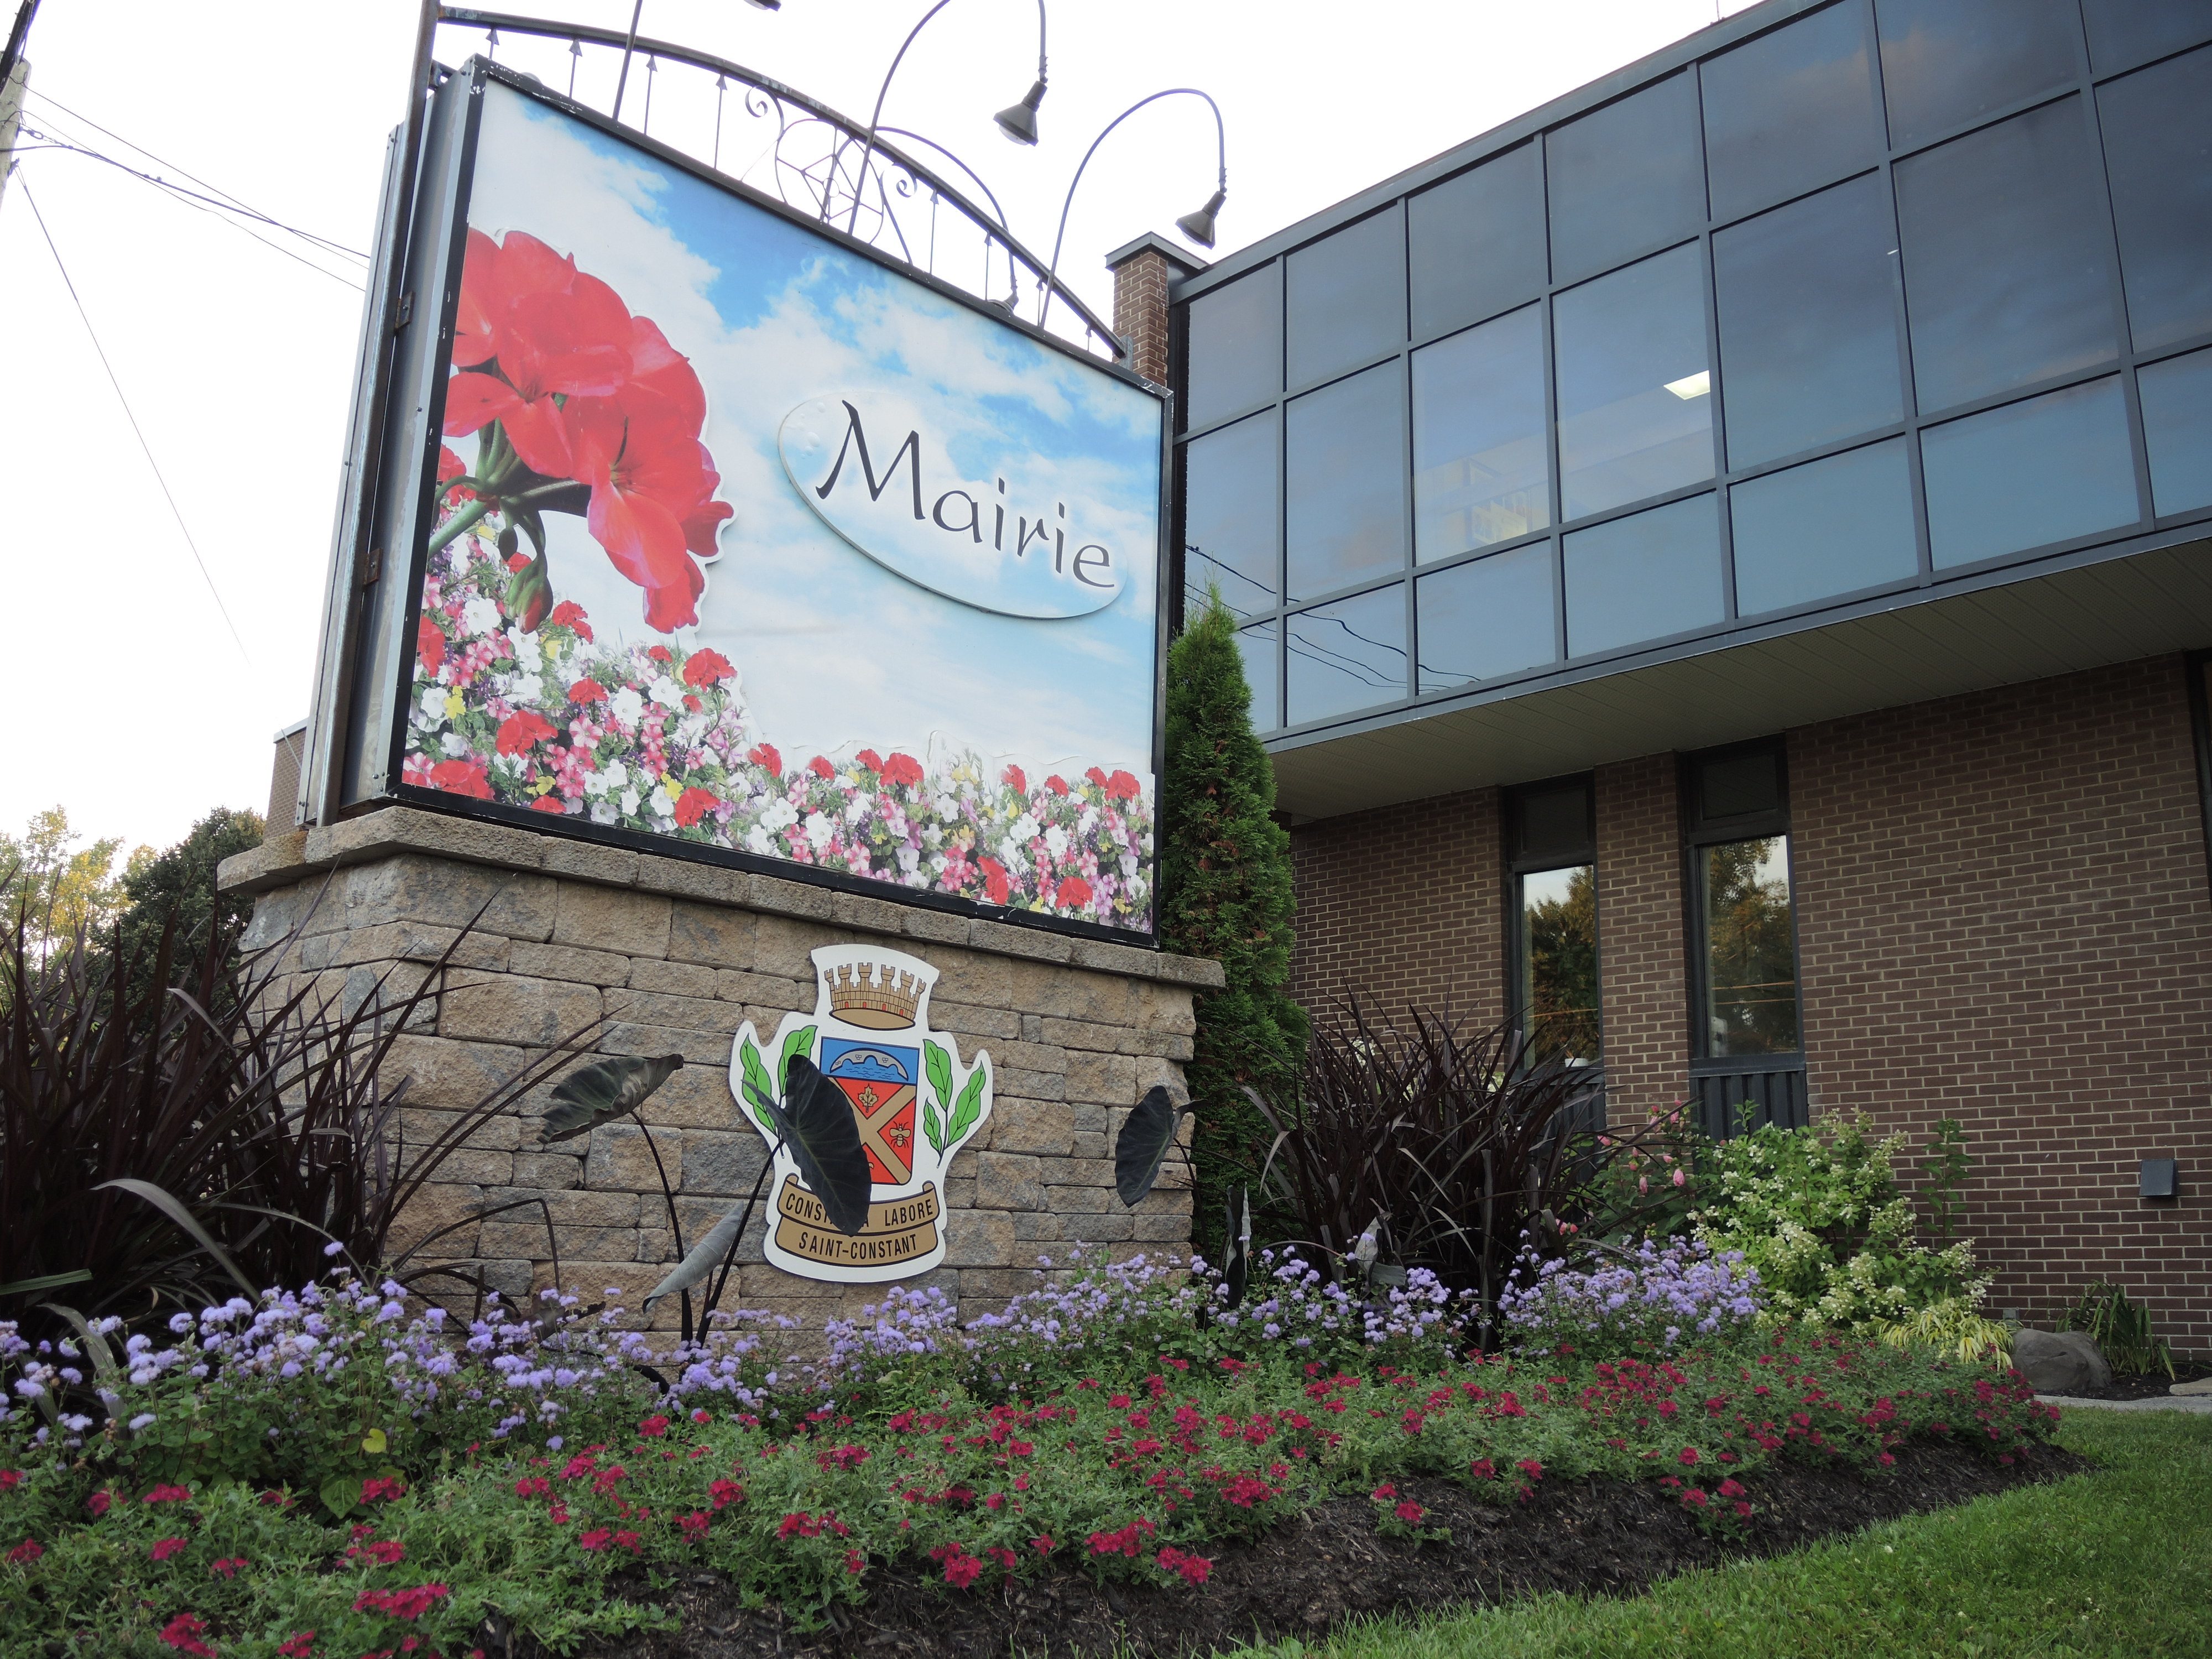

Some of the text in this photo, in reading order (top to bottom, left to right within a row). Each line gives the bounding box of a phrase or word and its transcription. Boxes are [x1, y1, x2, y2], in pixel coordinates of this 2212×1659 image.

[815, 399, 1115, 588] Mairie
[885, 1199, 933, 1227] LABORE
[799, 1232, 917, 1260] SAINT-CONSTANT
